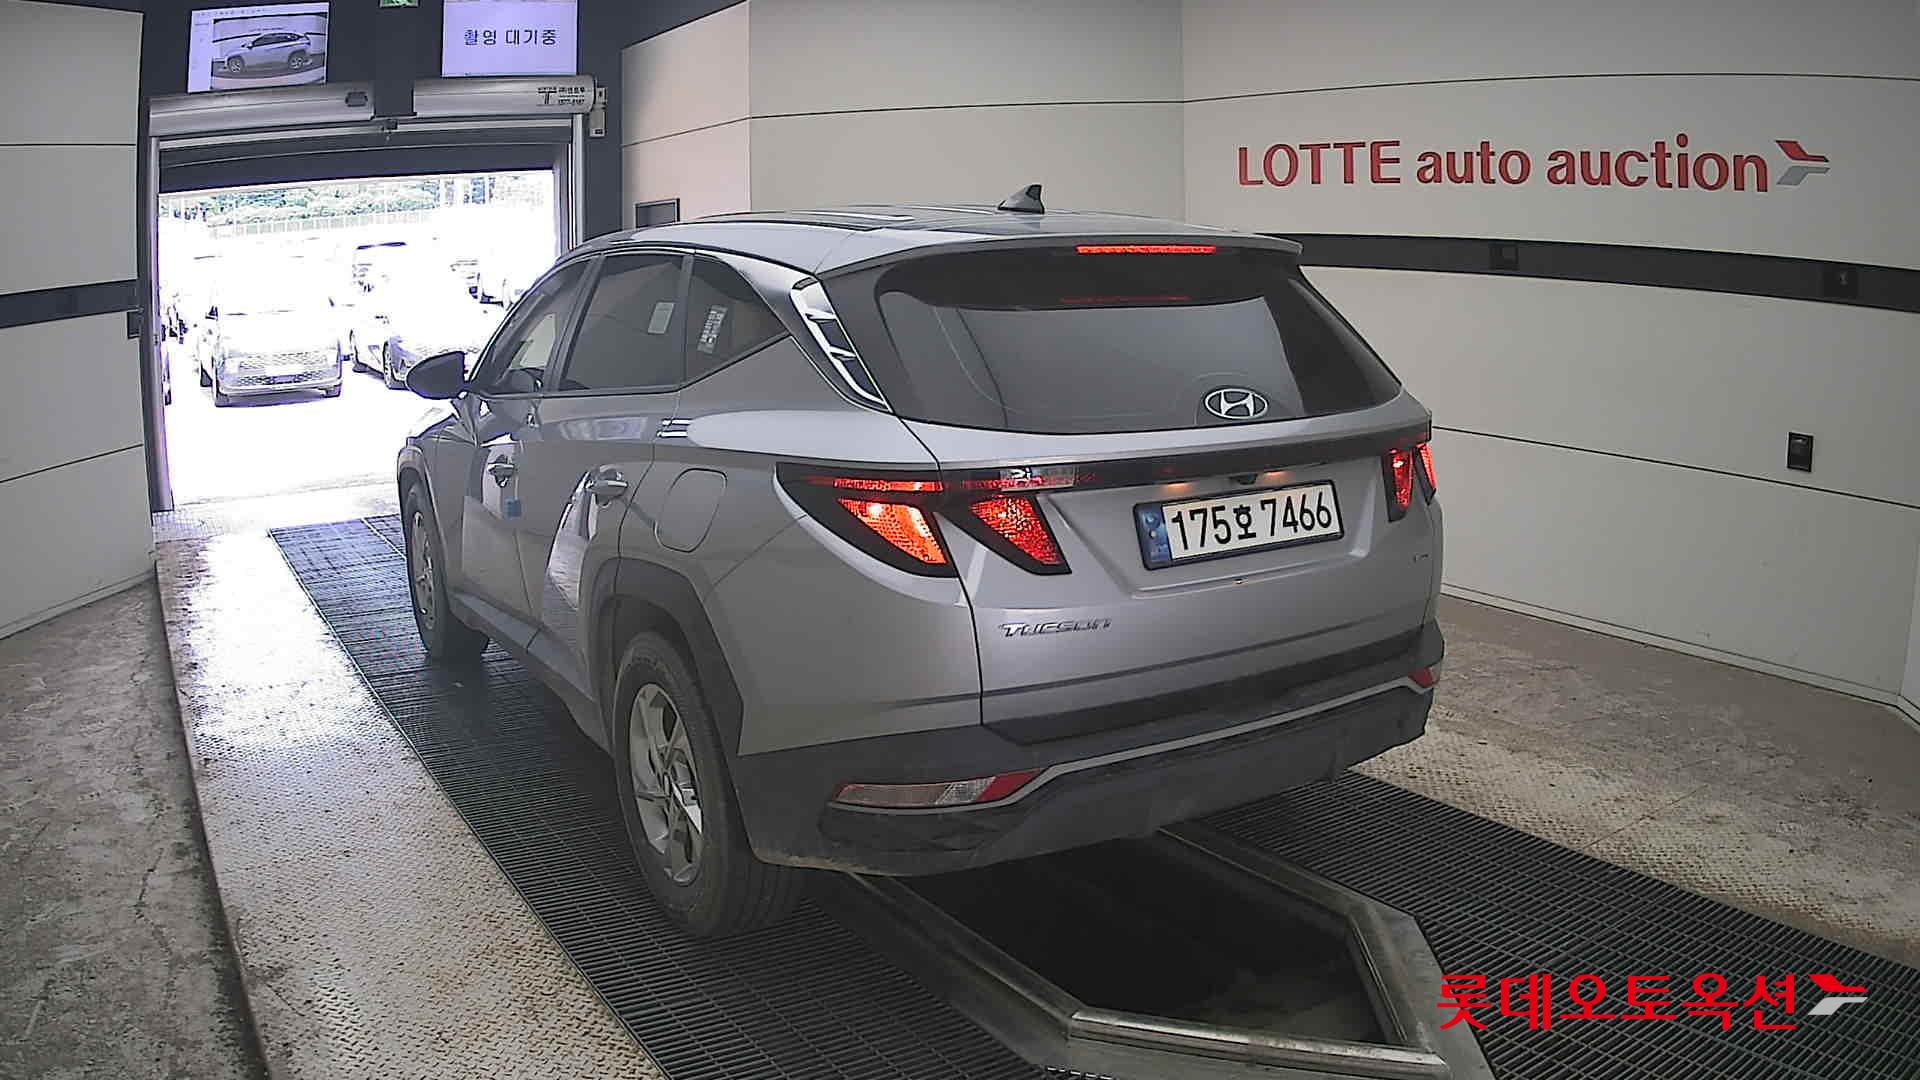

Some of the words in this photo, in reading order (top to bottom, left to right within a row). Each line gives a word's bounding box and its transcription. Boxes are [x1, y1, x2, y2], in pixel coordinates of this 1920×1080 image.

[464, 29, 497, 46] 촬영
[505, 29, 556, 46] 대기중
[1238, 140, 1401, 187] LOTTE
[1416, 141, 1532, 185] auto
[1546, 133, 1769, 192] auction
[1171, 504, 1257, 550] 175호
[1260, 491, 1333, 537] 7466
